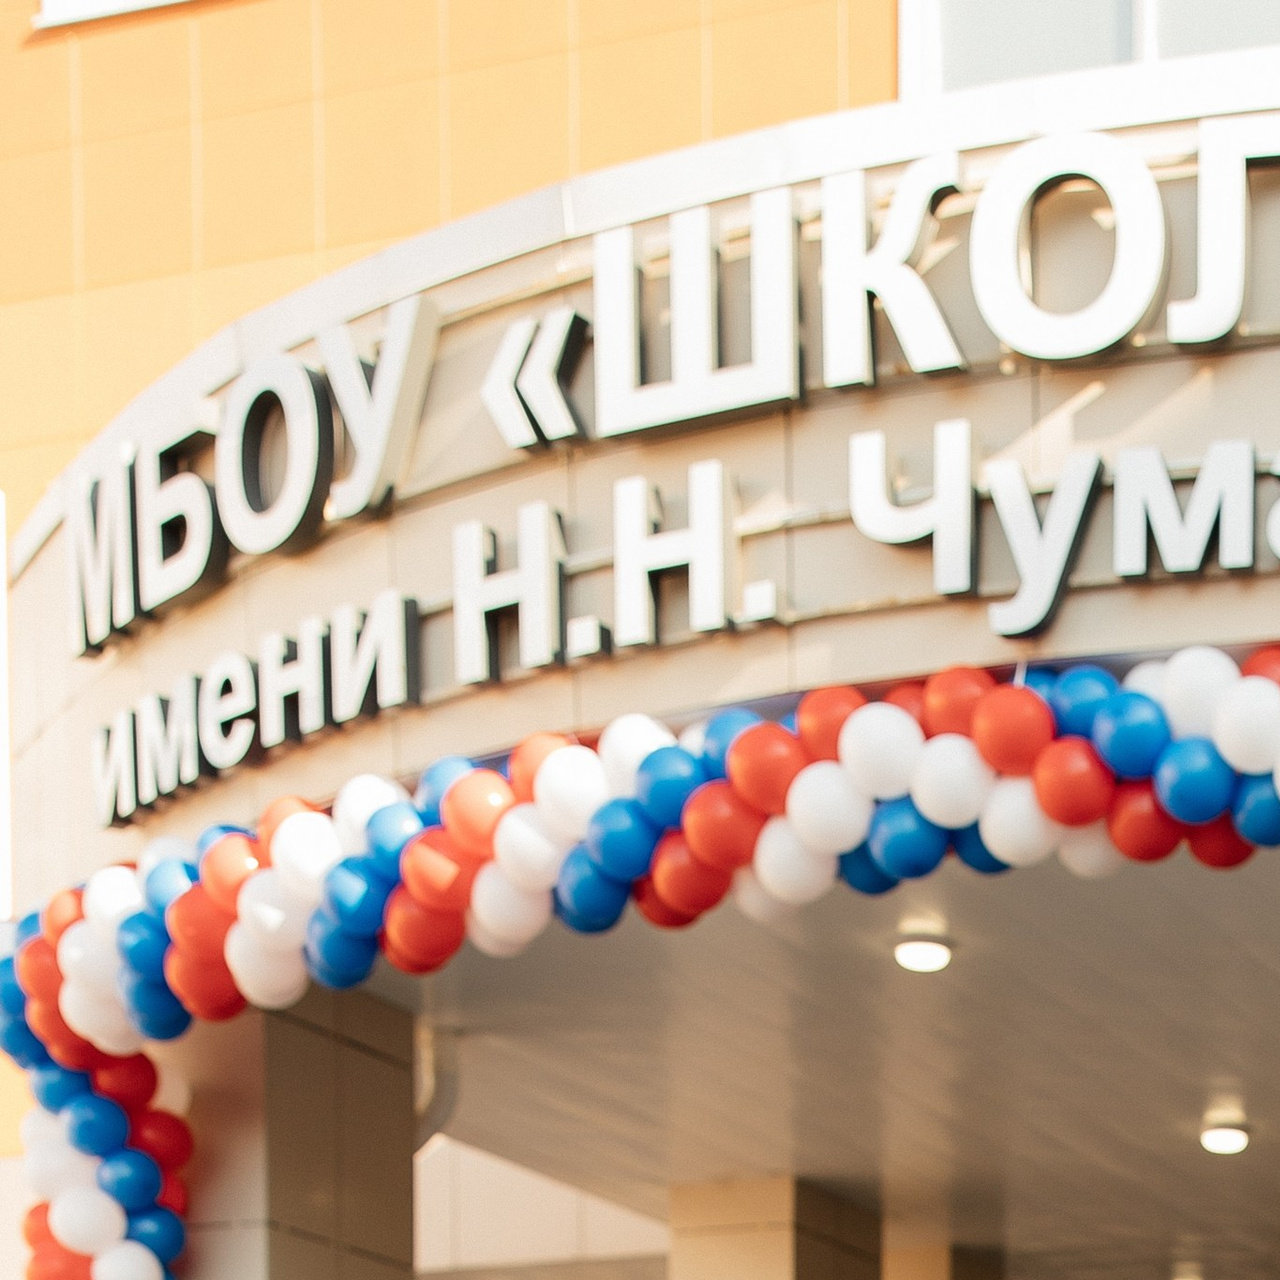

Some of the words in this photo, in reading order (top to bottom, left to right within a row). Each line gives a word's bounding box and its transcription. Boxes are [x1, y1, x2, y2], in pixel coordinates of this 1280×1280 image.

[64, 292, 438, 656] МБОУ
[93, 590, 408, 826] имени
[453, 458, 777, 683] Н.Н.
